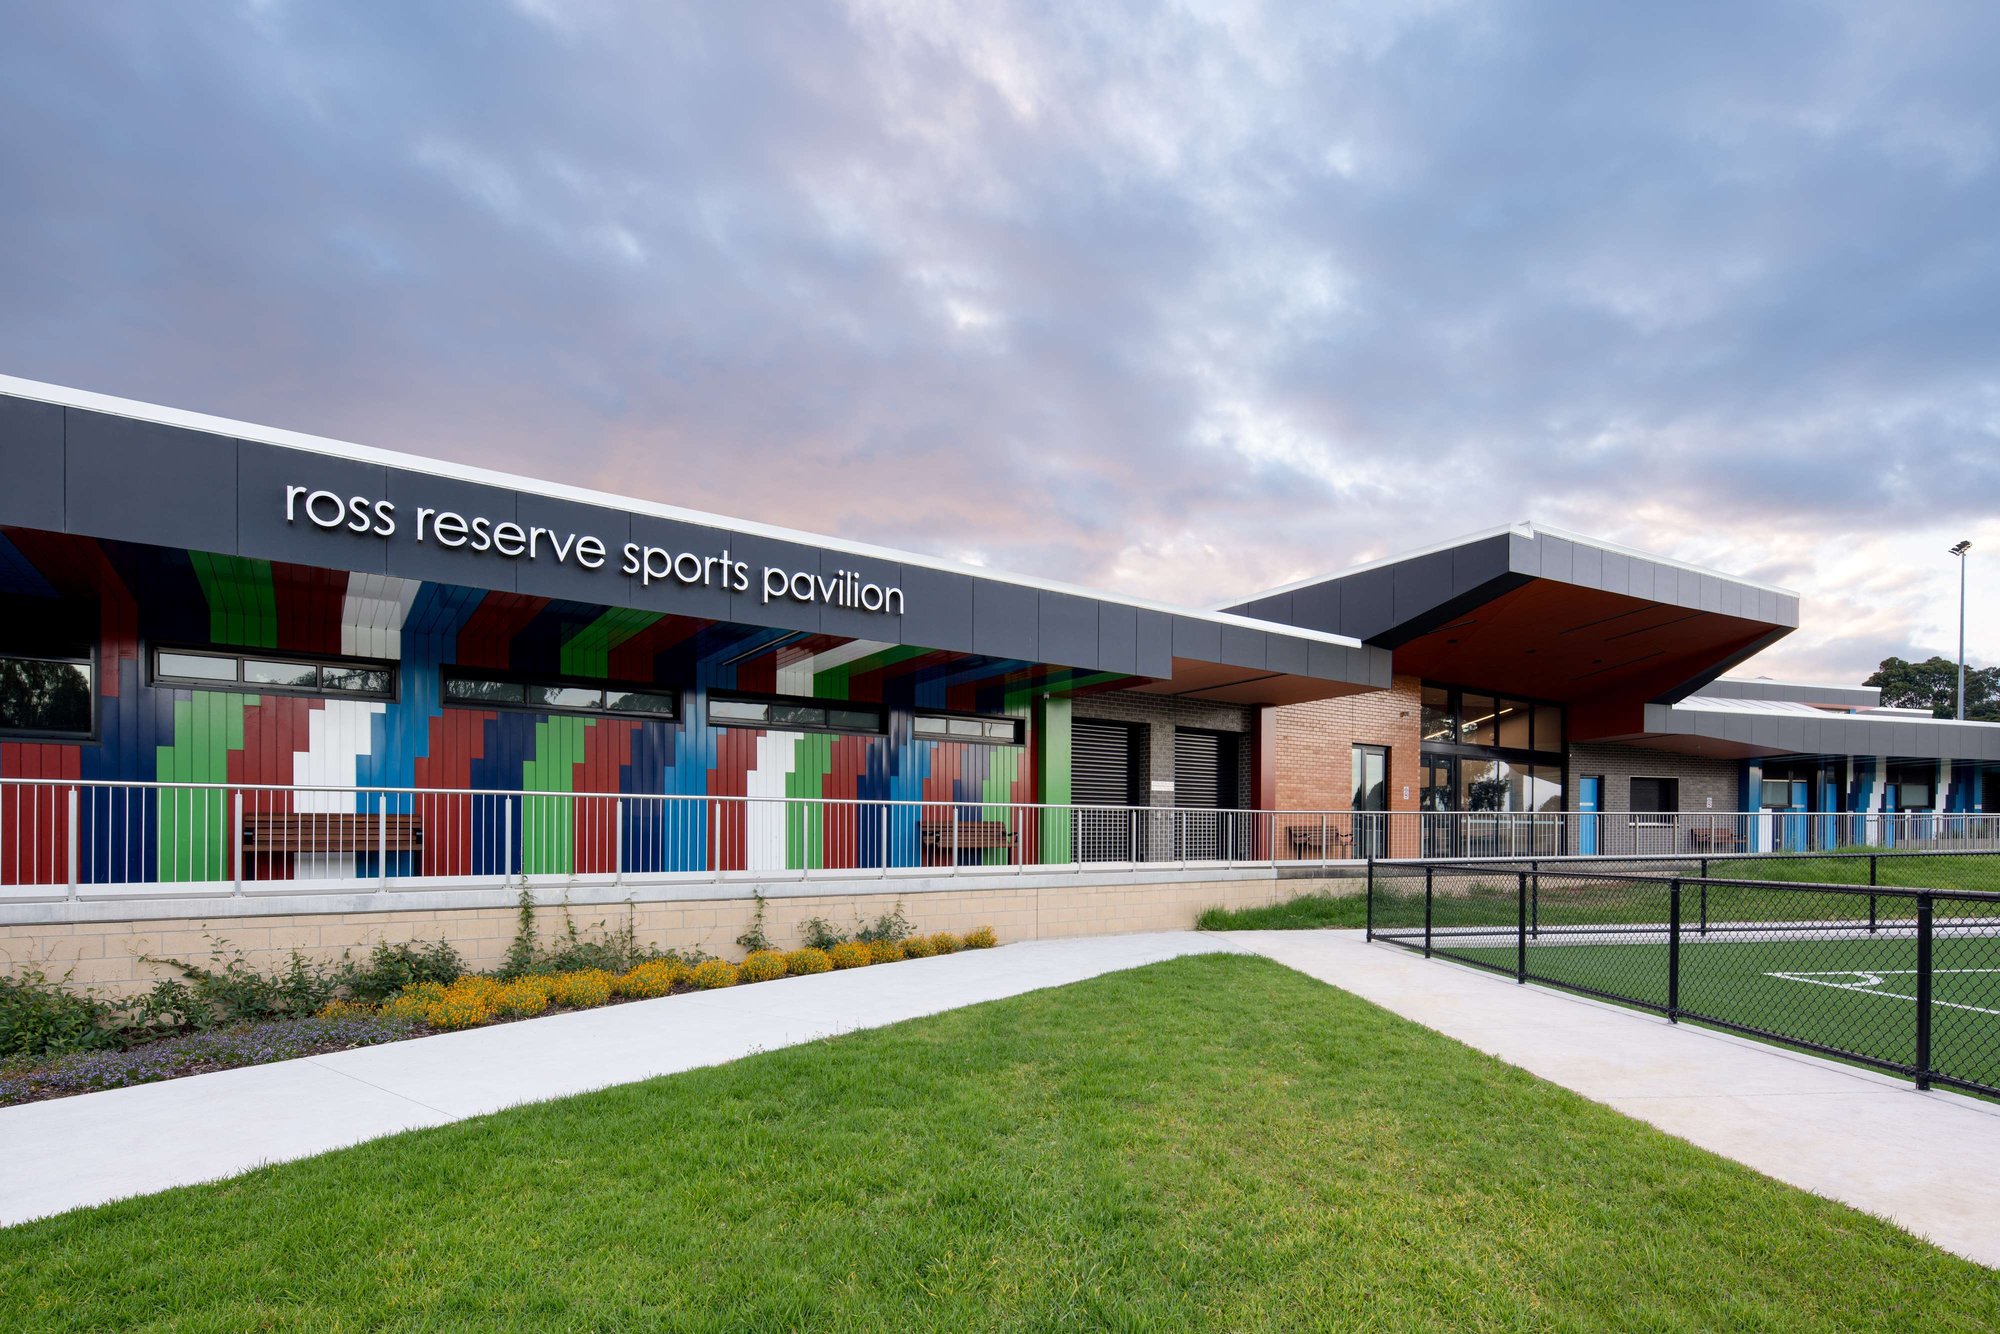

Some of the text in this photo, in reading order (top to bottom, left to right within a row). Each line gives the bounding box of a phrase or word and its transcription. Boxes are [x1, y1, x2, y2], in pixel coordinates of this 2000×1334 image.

[286, 484, 905, 615] ross reserve sports pavilion
